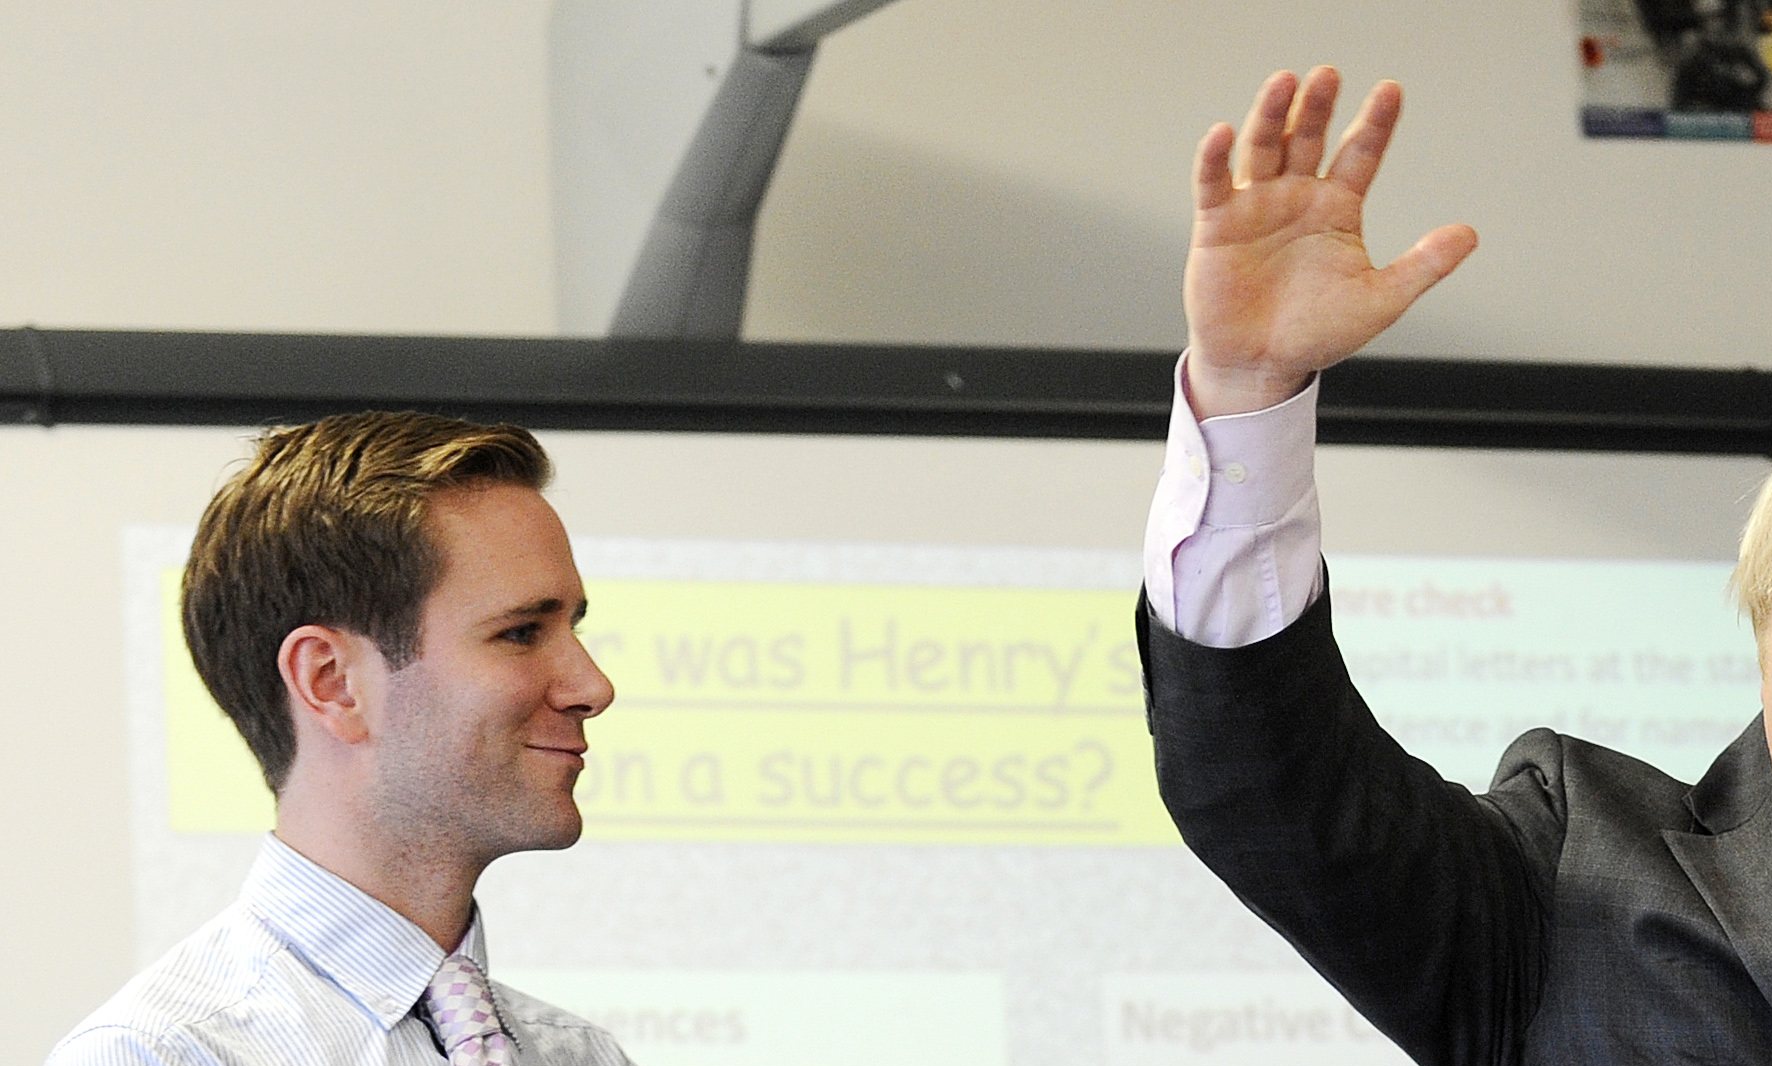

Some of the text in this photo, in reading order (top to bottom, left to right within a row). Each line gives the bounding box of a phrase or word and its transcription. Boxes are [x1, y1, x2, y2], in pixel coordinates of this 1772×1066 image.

[652, 613, 1141, 721] was Henry's
[1458, 645, 1579, 685] letters
[1586, 650, 1625, 685] at
[1632, 645, 1696, 685] the
[678, 750, 728, 806] a
[755, 736, 1118, 814] success?
[1119, 998, 1334, 1056] Negative
